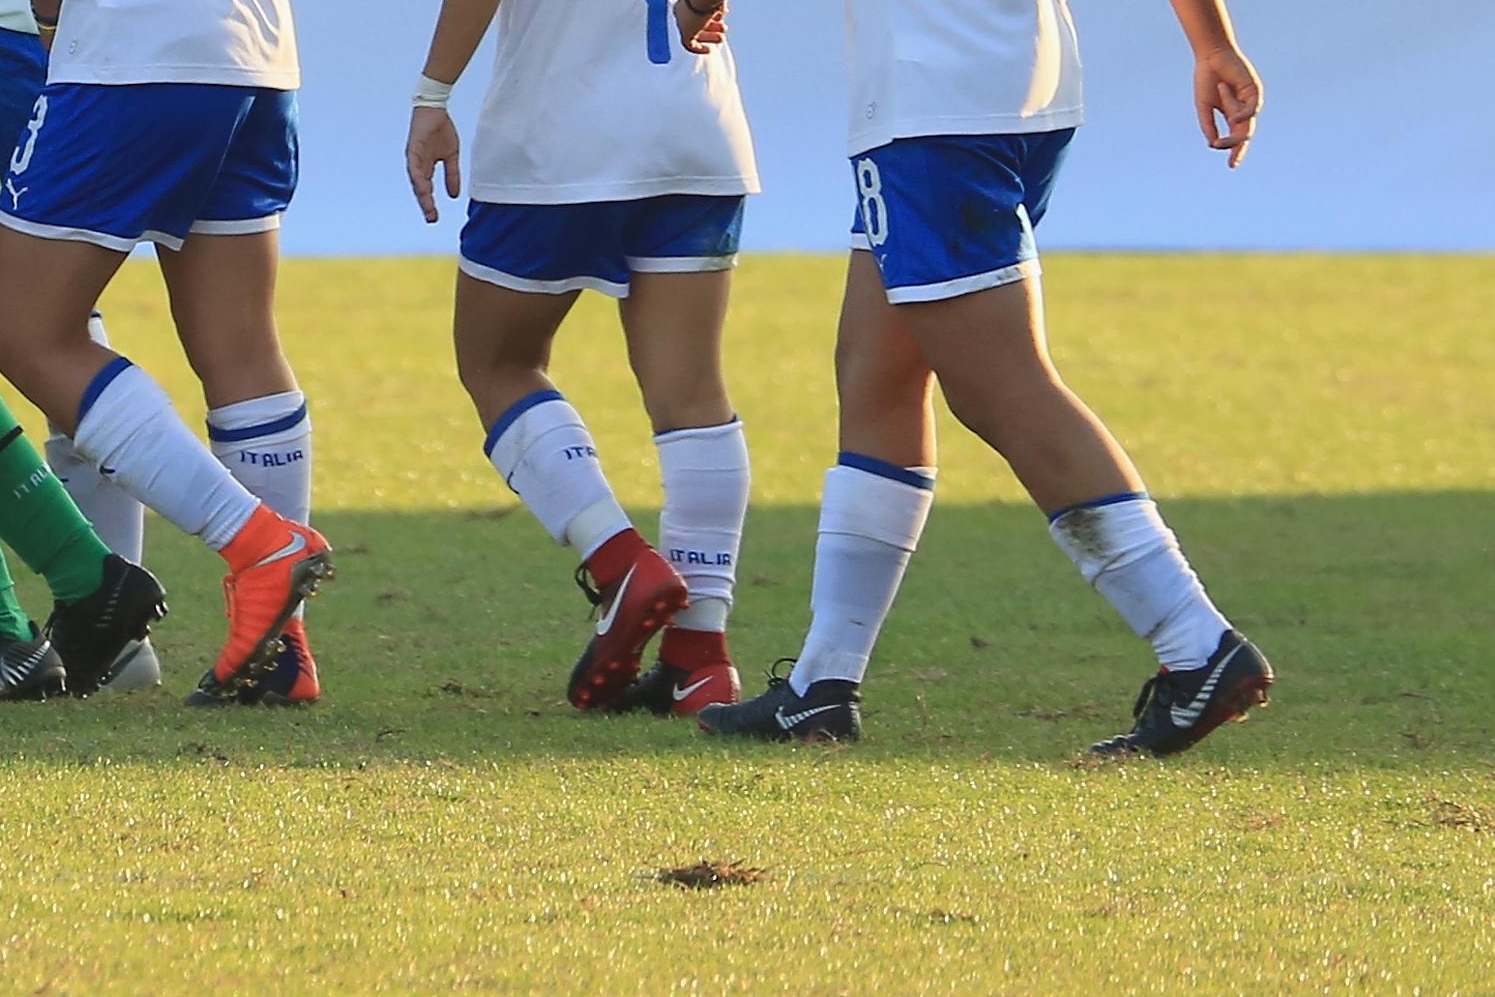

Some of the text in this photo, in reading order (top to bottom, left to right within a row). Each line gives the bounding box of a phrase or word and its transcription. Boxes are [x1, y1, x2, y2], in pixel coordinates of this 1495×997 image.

[10, 94, 48, 175] 3
[856, 156, 890, 247] 8
[240, 449, 303, 468] ITALIA
[670, 549, 731, 566] ITALIA
